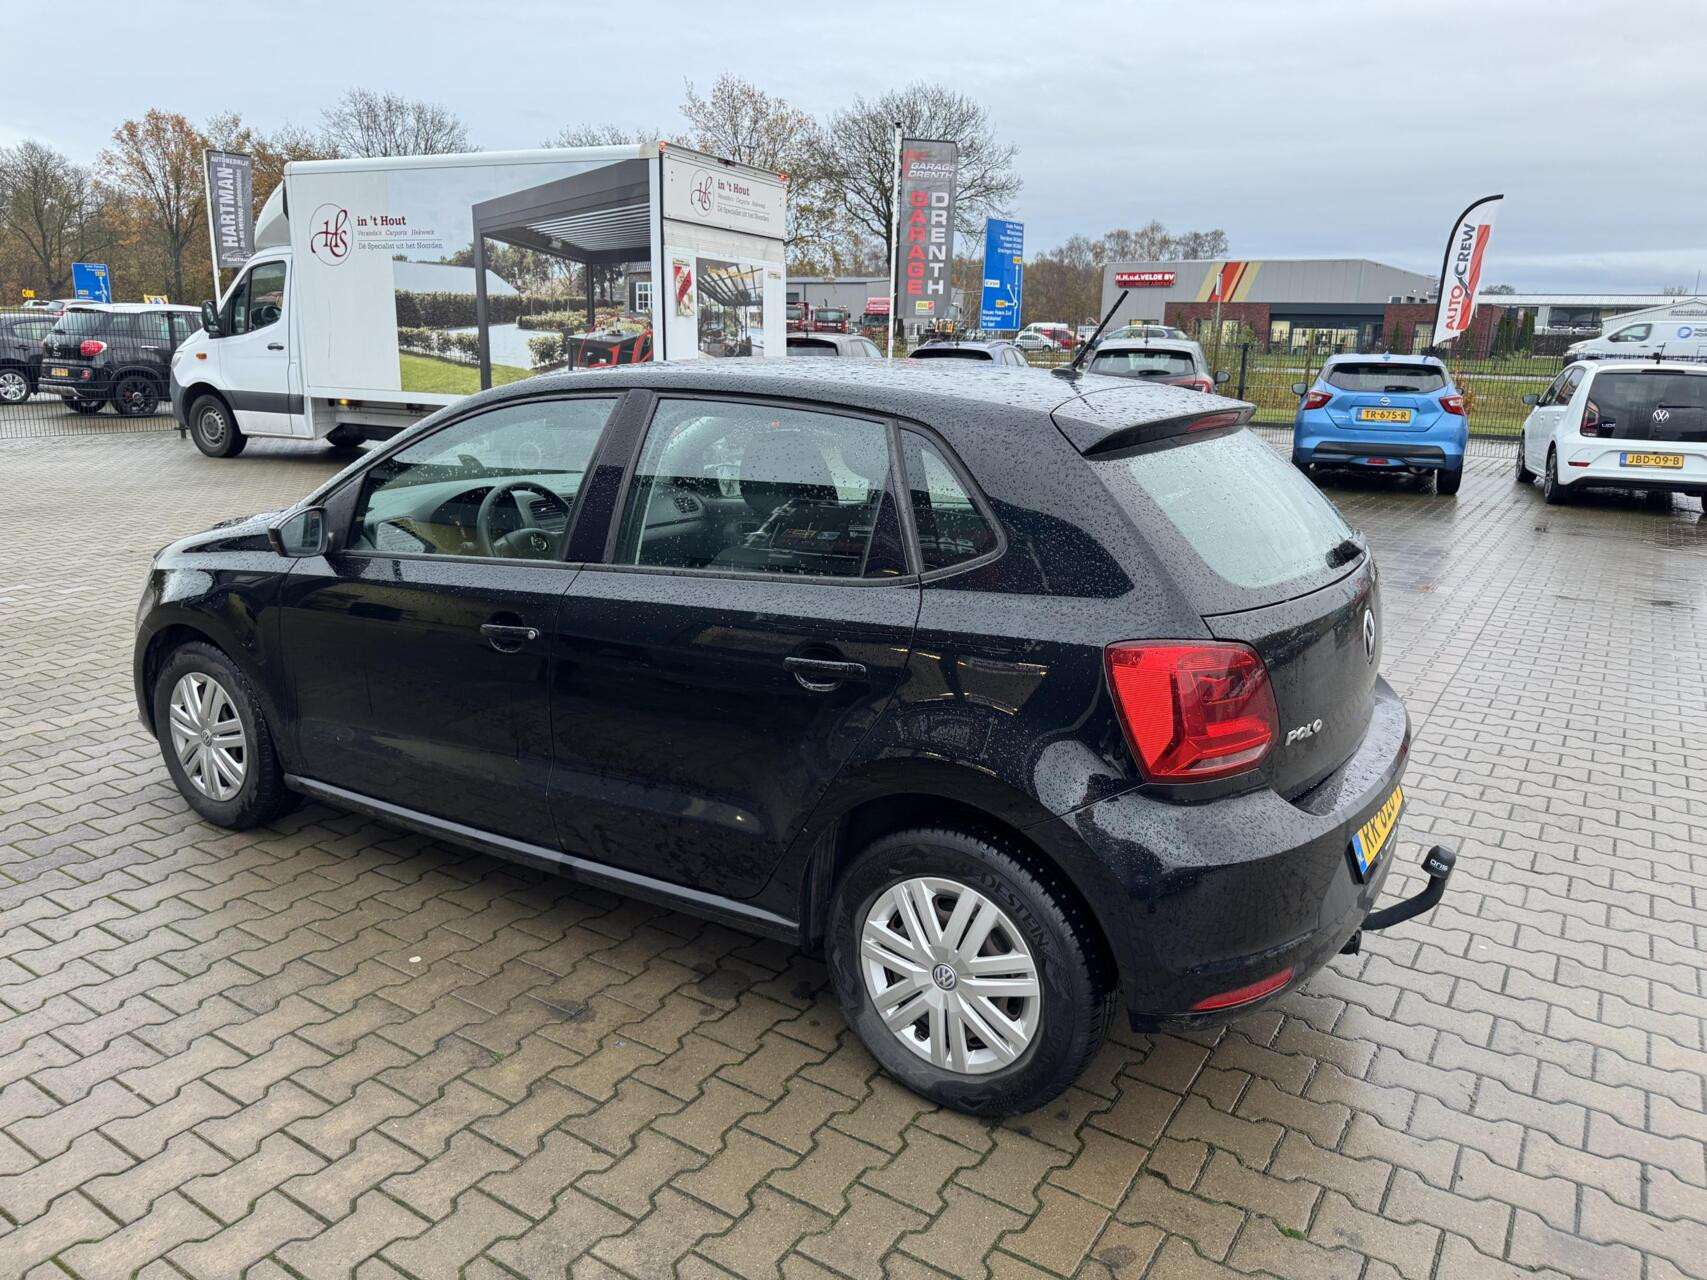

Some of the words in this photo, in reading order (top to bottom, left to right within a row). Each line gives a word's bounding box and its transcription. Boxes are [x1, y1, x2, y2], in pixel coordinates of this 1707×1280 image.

[911, 161, 955, 172] GARAGE
[907, 169, 953, 179] DRENTH
[733, 183, 750, 197] Hout
[216, 165, 239, 248] HARTMAN
[357, 216, 368, 226] in
[380, 215, 407, 226] Hout
[368, 242, 395, 251] Specialist
[396, 242, 404, 250] uit
[405, 242, 416, 250] het
[417, 241, 443, 250] Noorden
[906, 191, 929, 295] GARAGE
[927, 191, 950, 295] DRENTH
[1365, 410, 1407, 420] TR-675-R
[1628, 455, 1680, 466] JBD-09-B
[1285, 718, 1323, 747] POLO
